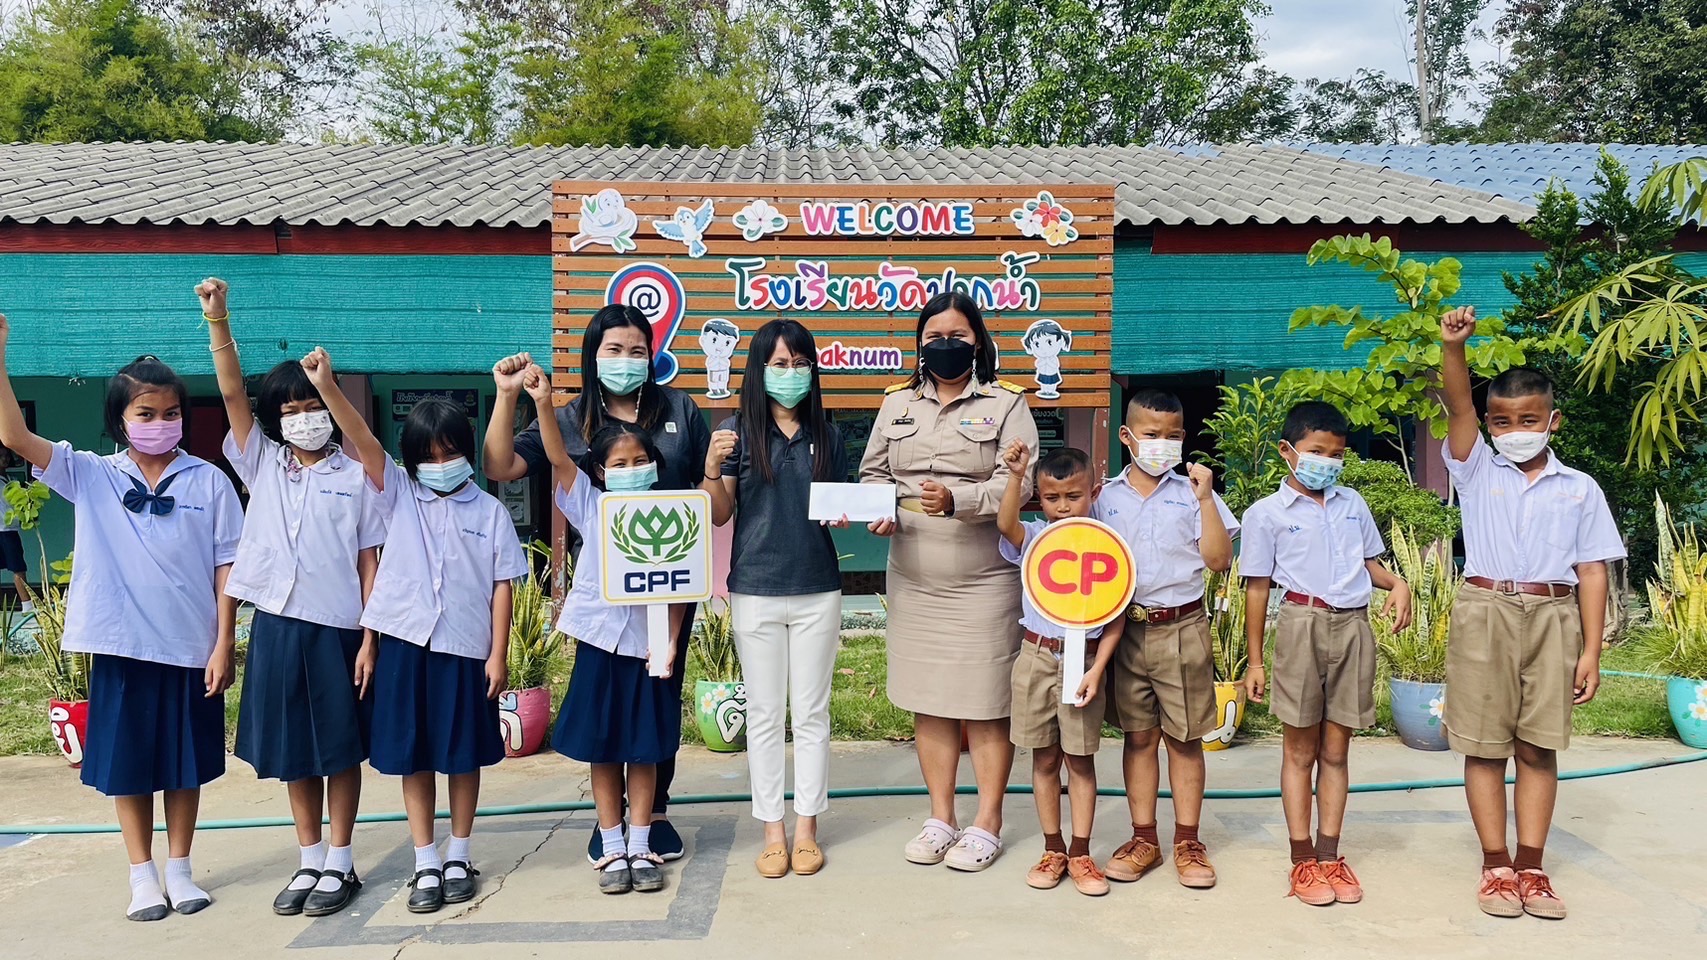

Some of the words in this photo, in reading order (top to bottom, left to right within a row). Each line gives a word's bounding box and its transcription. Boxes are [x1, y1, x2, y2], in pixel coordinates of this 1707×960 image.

[802, 205, 972, 232] WELCOME
[816, 344, 899, 366] aknum
[624, 569, 691, 593] CPF
[1038, 549, 1119, 596] CP
